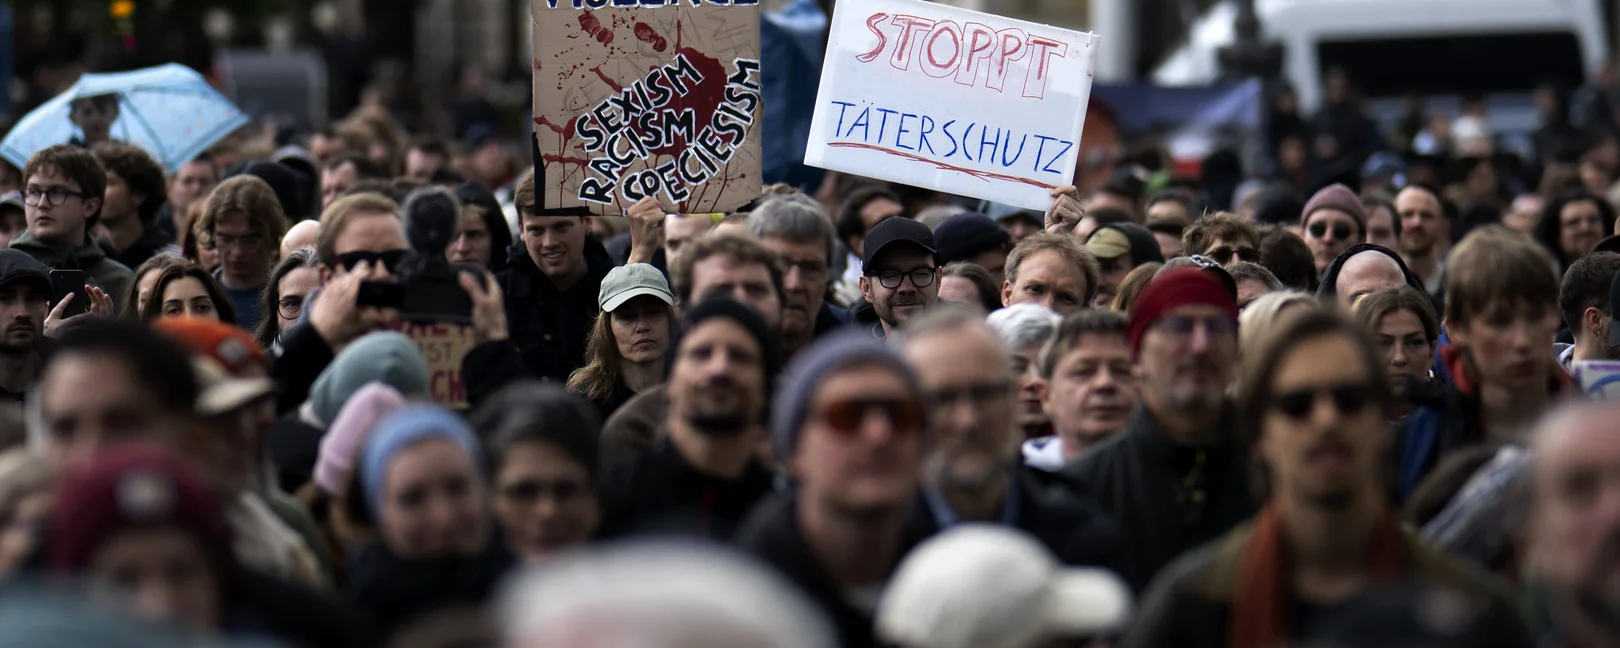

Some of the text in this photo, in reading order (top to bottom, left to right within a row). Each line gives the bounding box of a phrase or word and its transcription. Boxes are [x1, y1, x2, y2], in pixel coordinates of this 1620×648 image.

[855, 12, 1069, 100] STOPPT
[575, 53, 706, 153] SEXISM
[831, 99, 1074, 175] TÄTERSCHUTZ
[578, 107, 696, 205] RACISM
